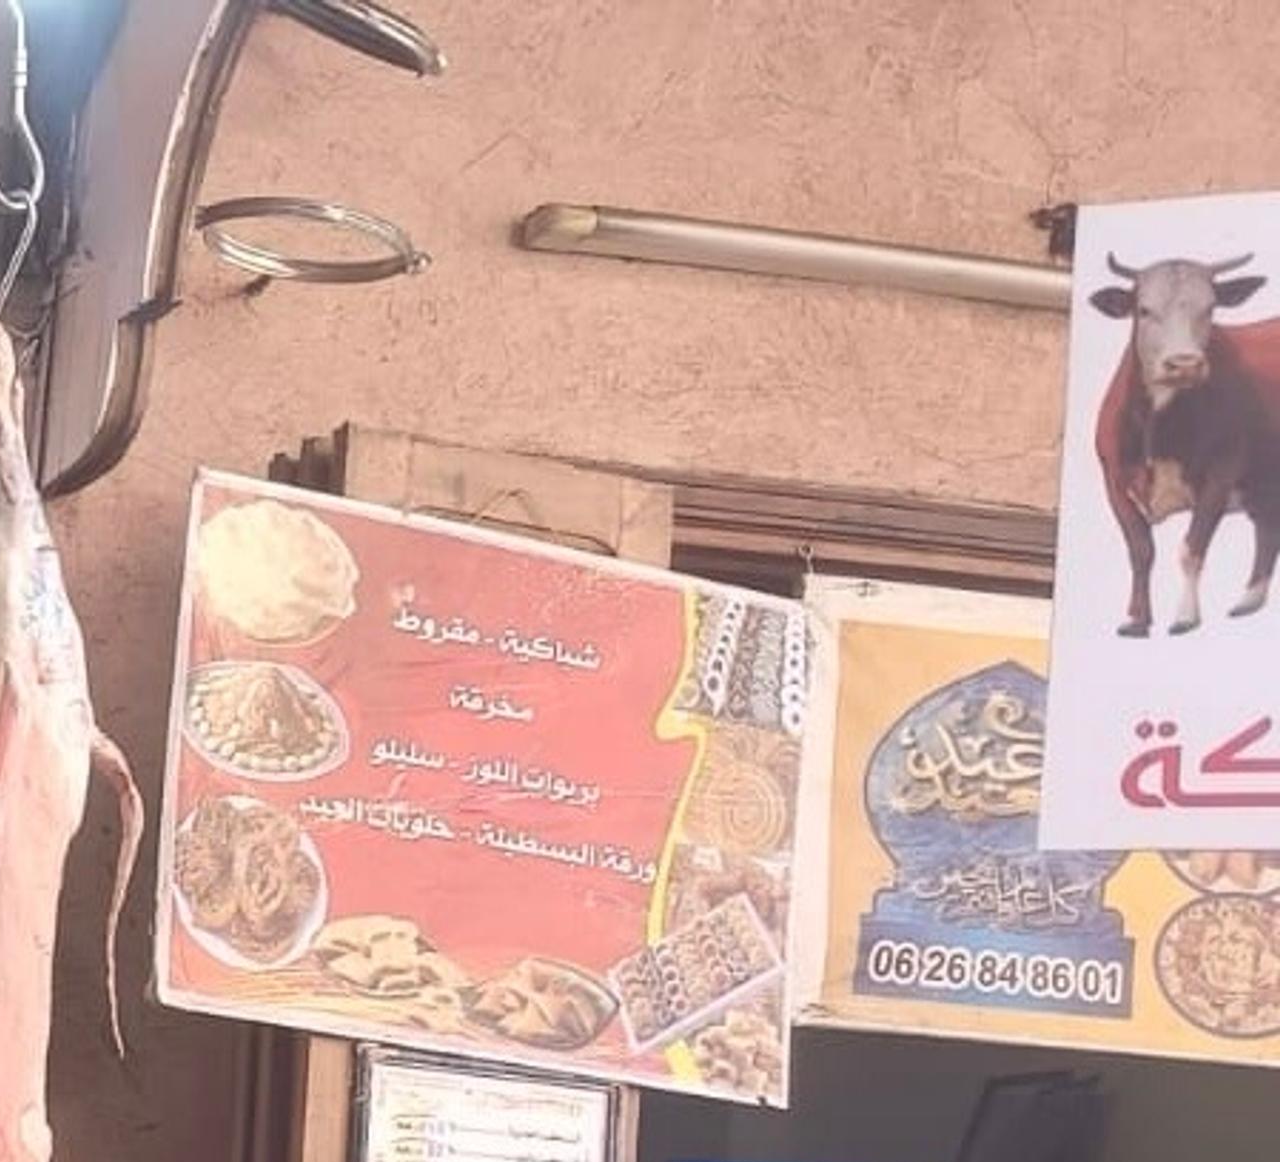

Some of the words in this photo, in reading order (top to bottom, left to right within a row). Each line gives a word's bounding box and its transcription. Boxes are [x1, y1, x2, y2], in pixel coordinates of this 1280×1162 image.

[872, 944, 916, 983] 06
[923, 947, 969, 986] 26
[976, 951, 1021, 990] 84
[1028, 956, 1073, 996] 86
[1079, 961, 1124, 1001] 01
